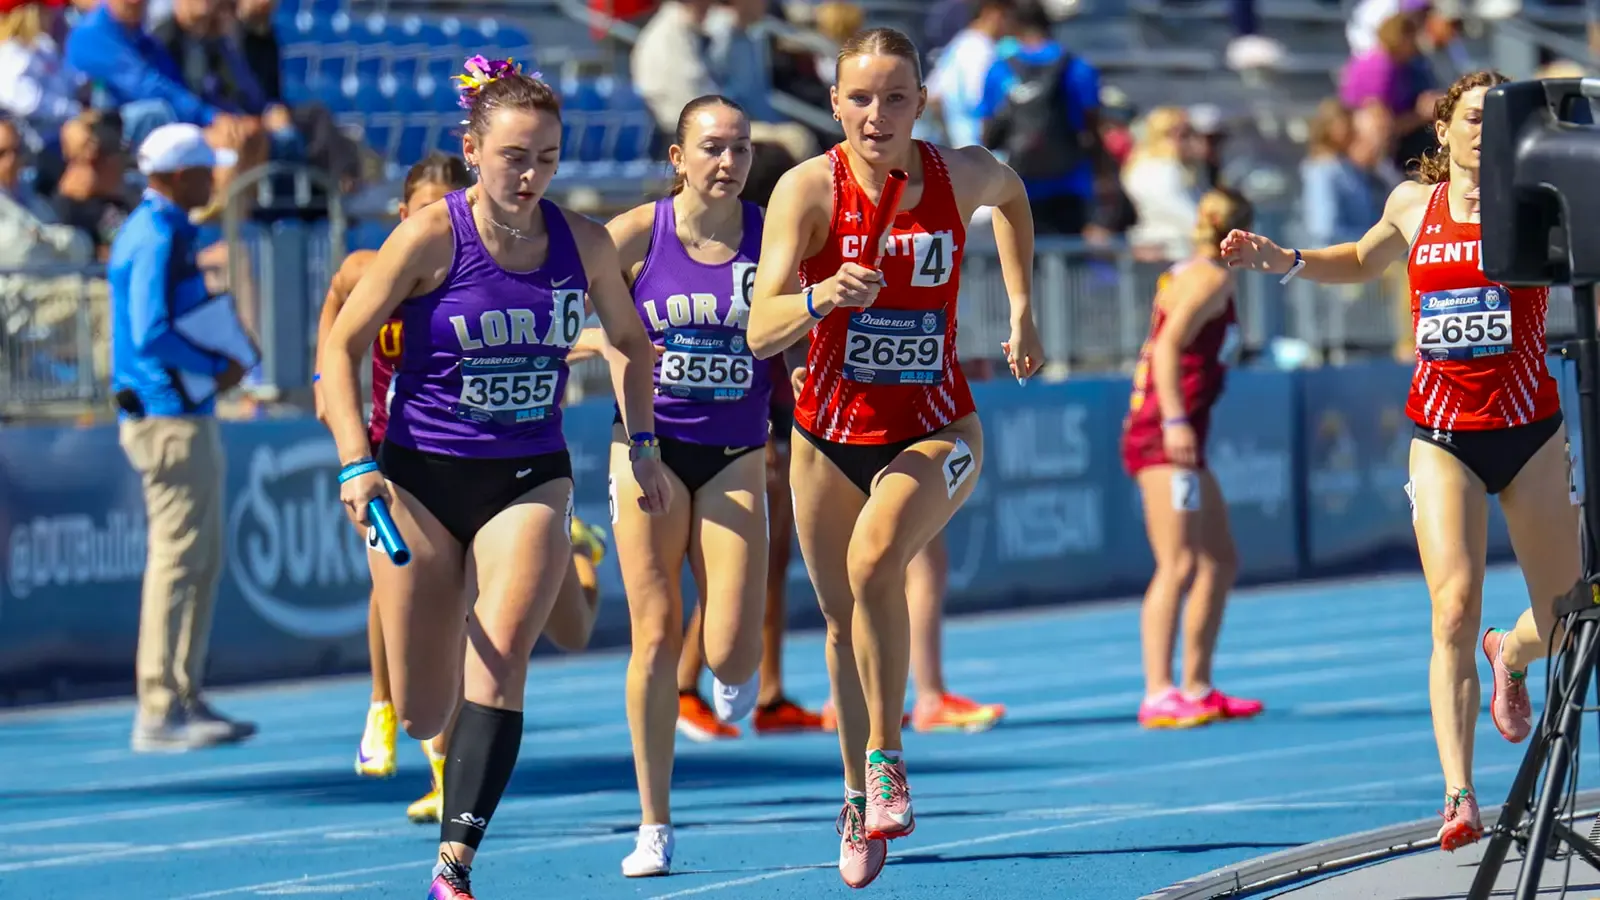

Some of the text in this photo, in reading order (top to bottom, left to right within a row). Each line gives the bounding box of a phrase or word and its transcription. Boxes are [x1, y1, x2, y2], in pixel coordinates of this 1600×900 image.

[920, 238, 946, 284] 4
[1415, 239, 1483, 265] CENT
[1454, 296, 1479, 305] RELAYS
[563, 292, 579, 343] 6
[859, 313, 916, 328] Drake RELAYS
[1421, 313, 1508, 344] 2655
[849, 334, 938, 366] 2659
[665, 354, 749, 384] 3556
[466, 374, 553, 406] 3555
[948, 453, 972, 489] 4
